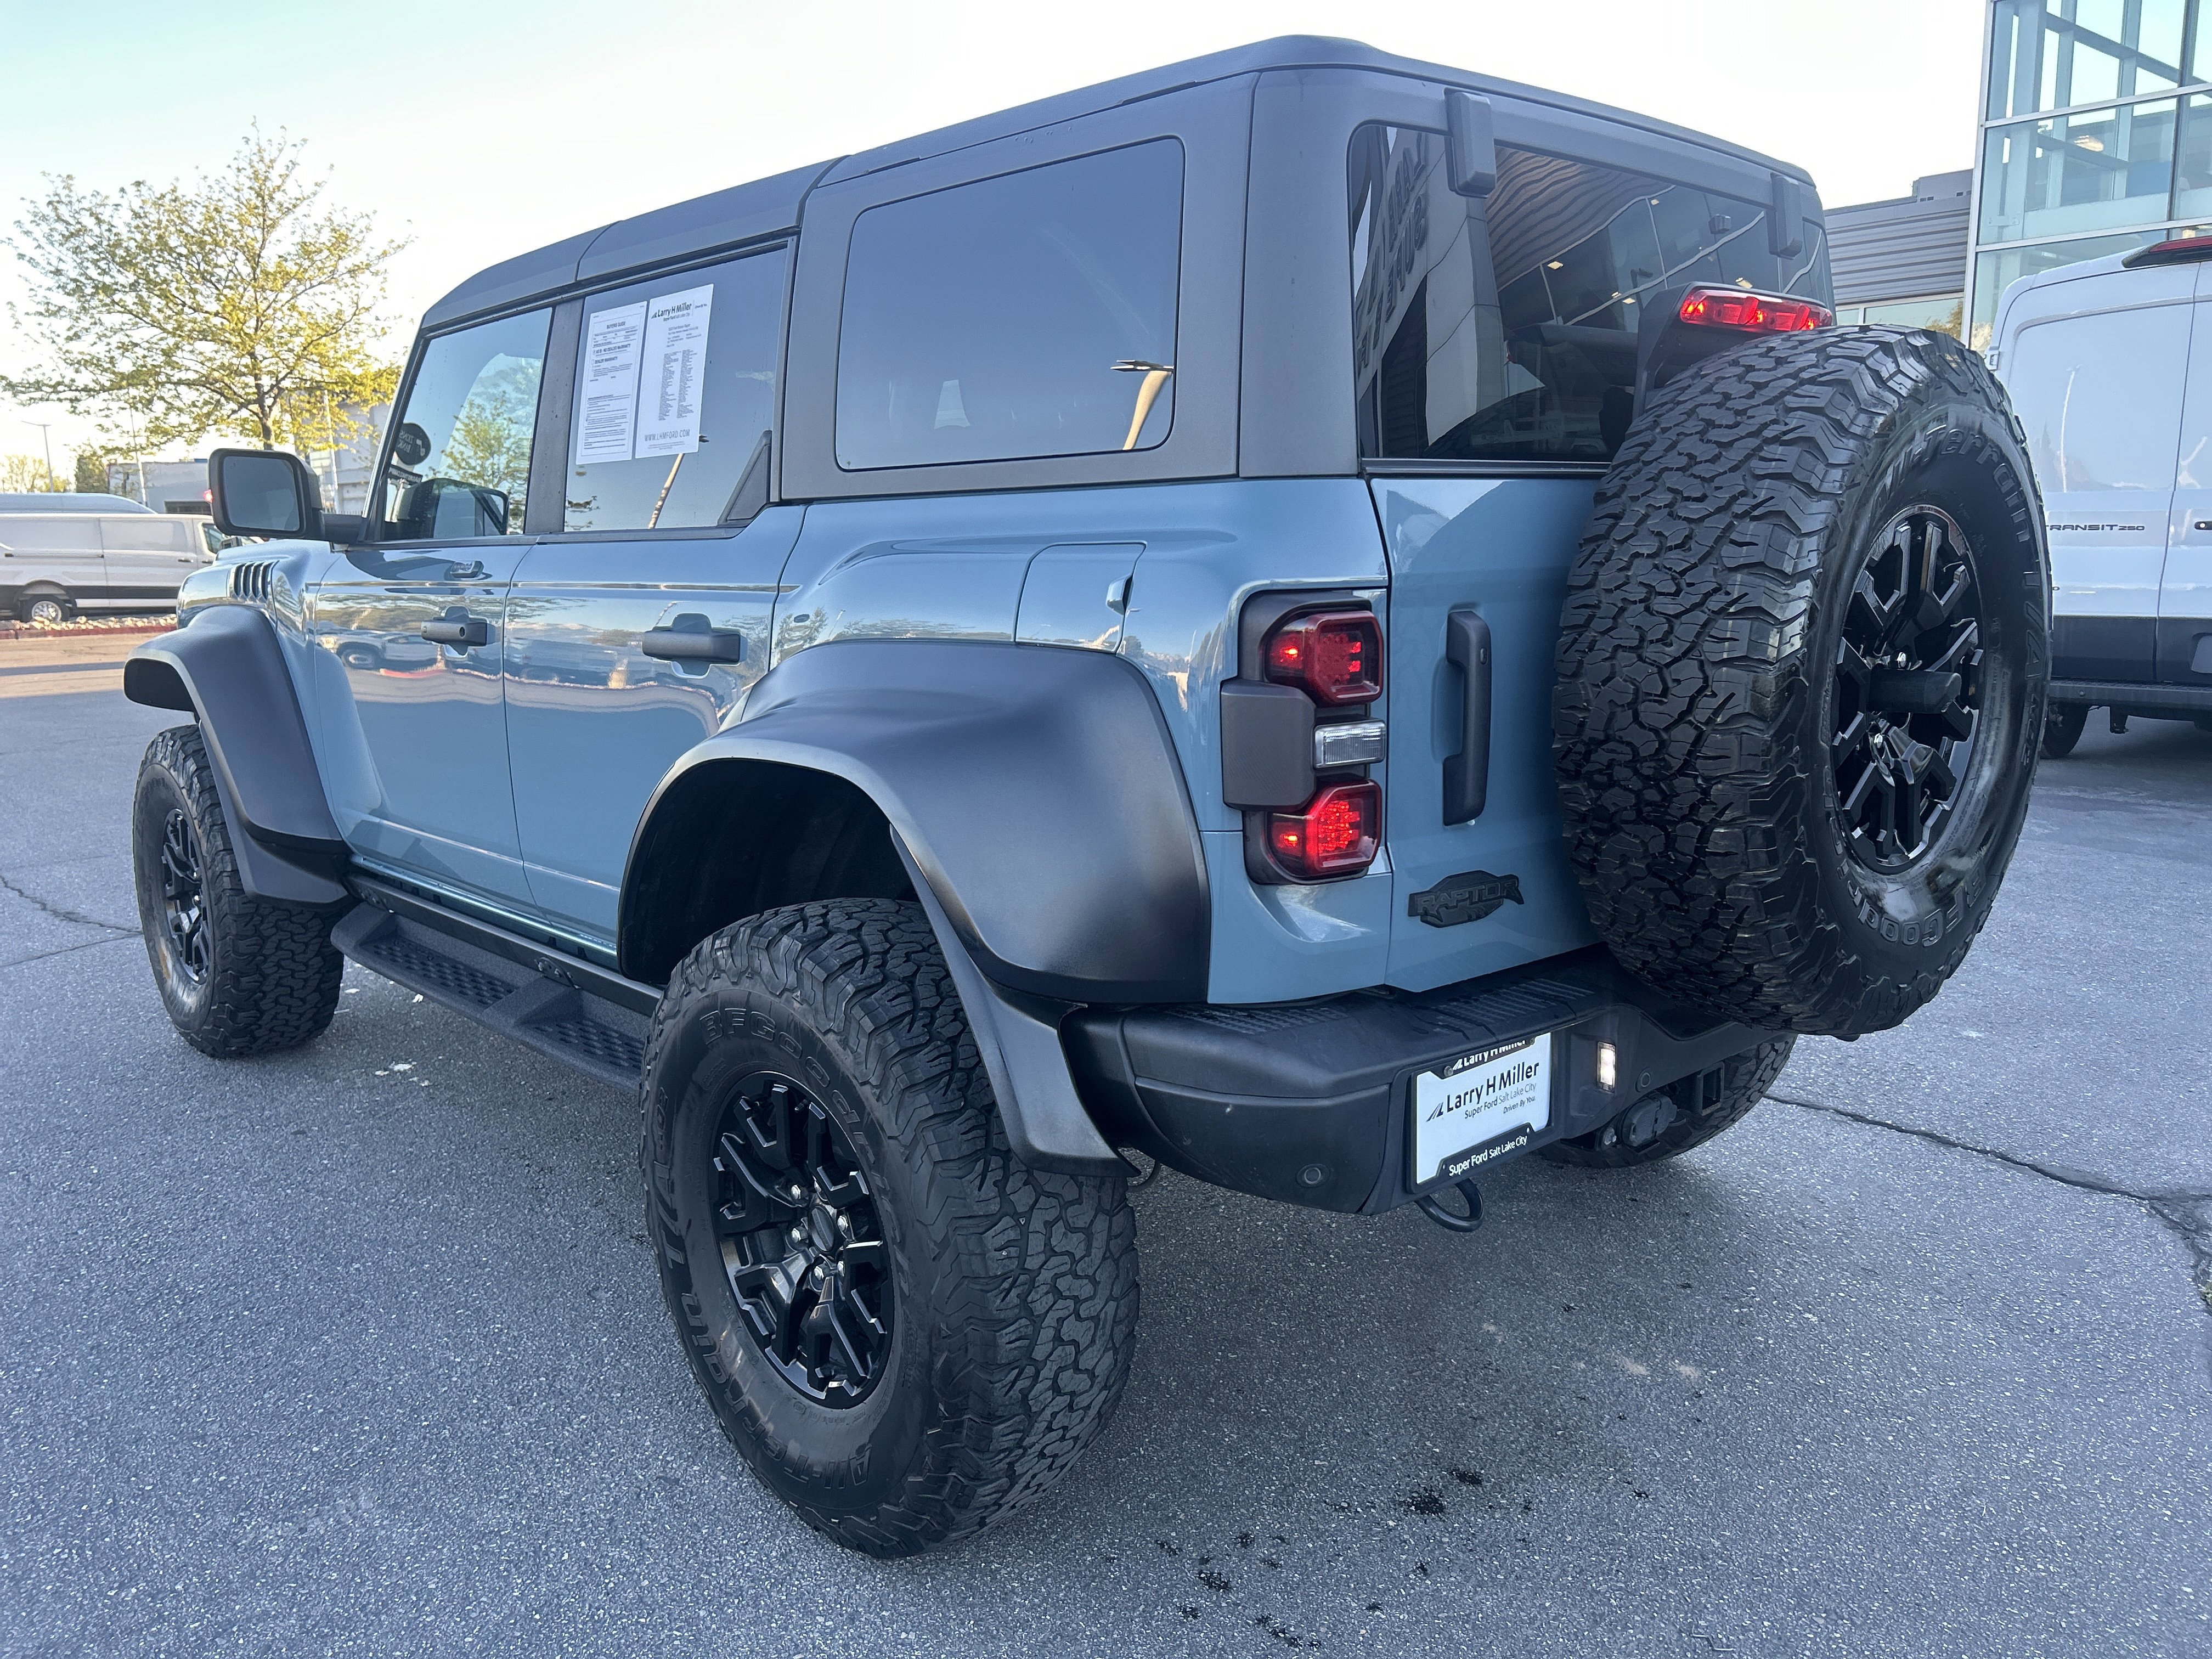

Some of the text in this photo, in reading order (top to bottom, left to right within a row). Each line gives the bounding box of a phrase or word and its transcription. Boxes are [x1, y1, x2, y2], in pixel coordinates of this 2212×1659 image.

[658, 302, 692, 317] Larry H Miller
[1415, 878, 1525, 923] RAPTOR
[1464, 1051, 1488, 1066] Larry
[1446, 1062, 1540, 1114] Larry H Miller
[1464, 1082, 1537, 1120] Super Ford Salt Lake City
[1503, 1103, 1519, 1114] Driven
[1520, 1099, 1526, 1109] By
[1449, 1158, 1471, 1177] Super
[1471, 1149, 1488, 1167] Ford
[1501, 1141, 1515, 1154] Lake
[1515, 1135, 1527, 1147] City
